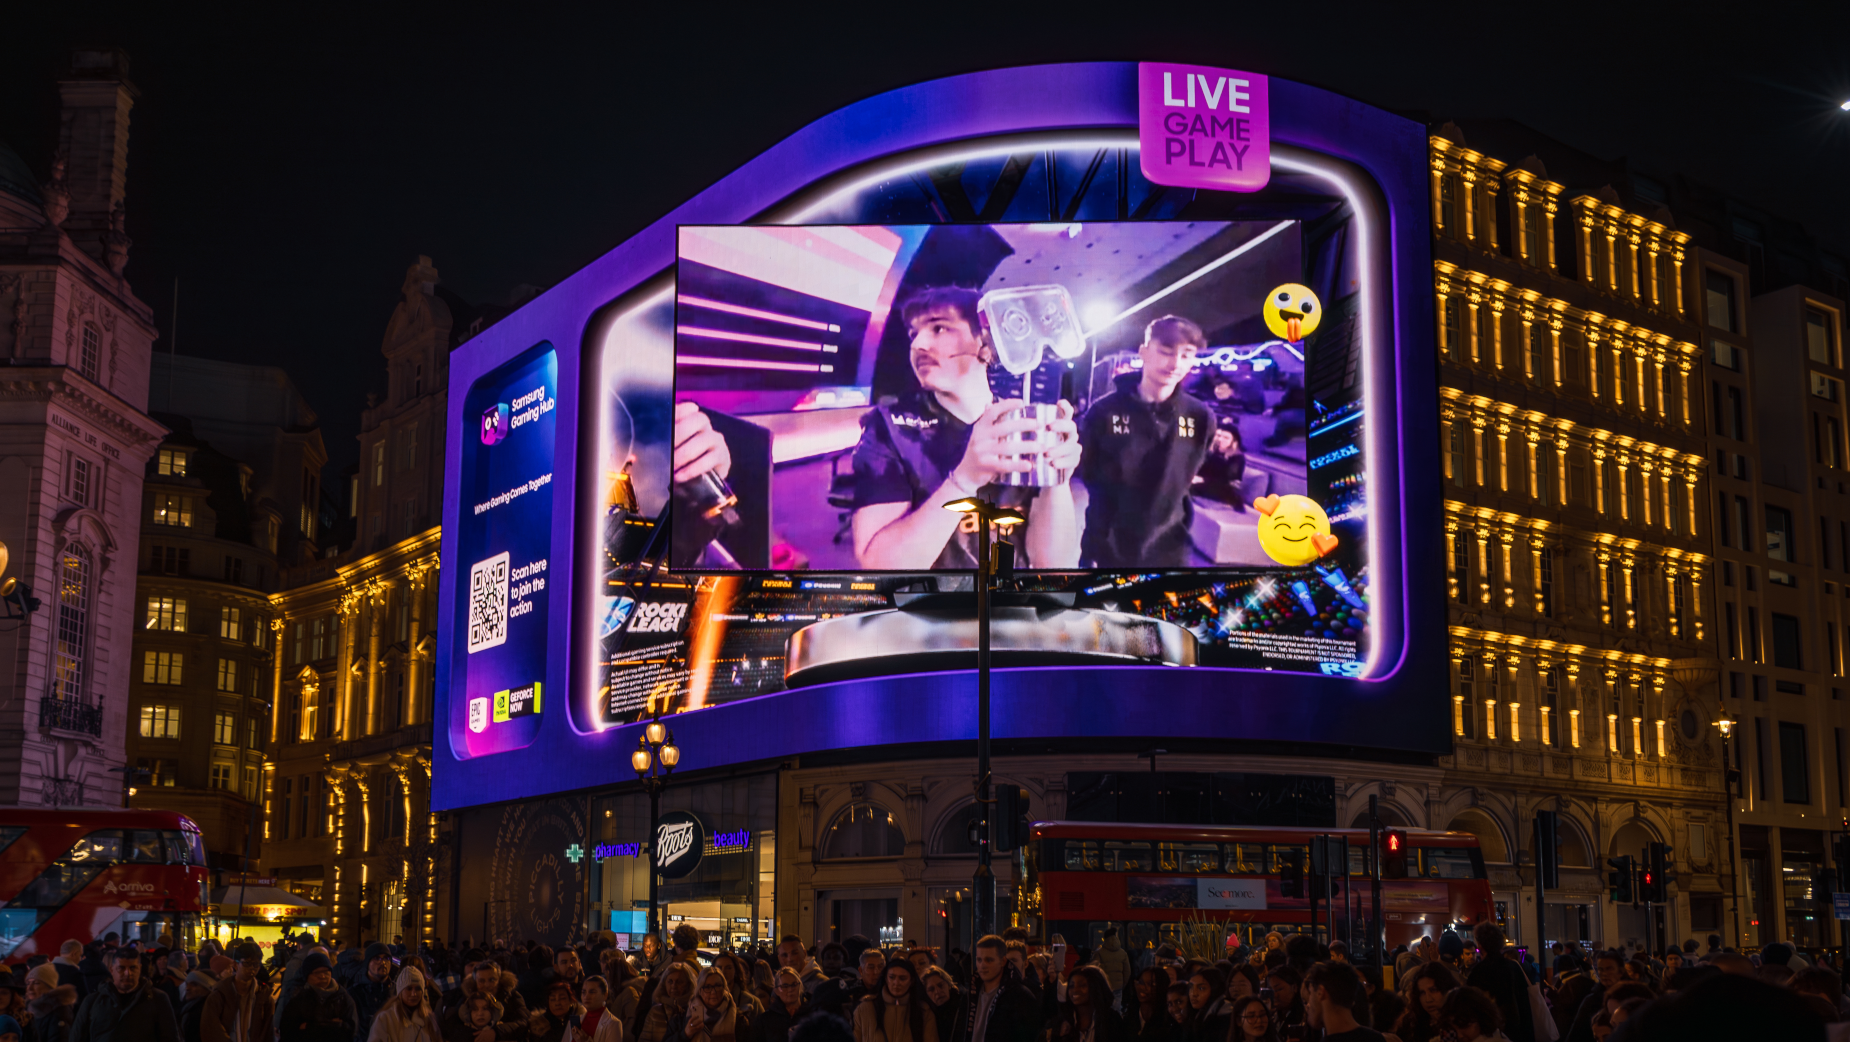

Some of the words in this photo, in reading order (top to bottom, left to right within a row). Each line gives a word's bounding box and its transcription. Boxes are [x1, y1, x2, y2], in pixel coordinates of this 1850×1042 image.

[1164, 72, 1250, 114] LIVE
[1164, 112, 1250, 142] GAME
[1166, 137, 1250, 171] PLAY
[511, 386, 545, 412] Samsung
[511, 406, 540, 429] Gaming
[540, 397, 555, 415] Hub
[52, 413, 80, 437] ALLIANCE
[84, 431, 97, 447] LIFE
[101, 441, 120, 460] OFFICE
[474, 501, 490, 515] Where
[490, 492, 510, 504] Gaming
[510, 483, 528, 499] Comes
[528, 472, 552, 491] Together
[511, 565, 529, 582] Scan
[530, 559, 547, 575] here
[511, 586, 519, 600] to
[518, 580, 532, 601] join
[533, 578, 545, 592] the
[510, 600, 533, 618] action
[510, 688, 533, 703] GEFORCE
[510, 701, 523, 713] NOW
[471, 702, 480, 717] EPIC
[570, 810, 584, 837] AND
[657, 821, 694, 867] Boots
[714, 828, 750, 848] beauty
[490, 827, 503, 878] HEART
[505, 847, 516, 885] WITH
[513, 818, 526, 844] YOU
[595, 842, 640, 861] pharmacy
[118, 881, 154, 891] arriva
[528, 853, 564, 904] PICCADILLY
[1207, 886, 1225, 898] See
[1228, 889, 1255, 898] more.
[241, 906, 260, 915] HOT
[284, 907, 307, 915] SPOT
[530, 907, 561, 934] LIGHTS
[565, 891, 582, 945] BEATIN
[708, 935, 722, 943] DIOR
